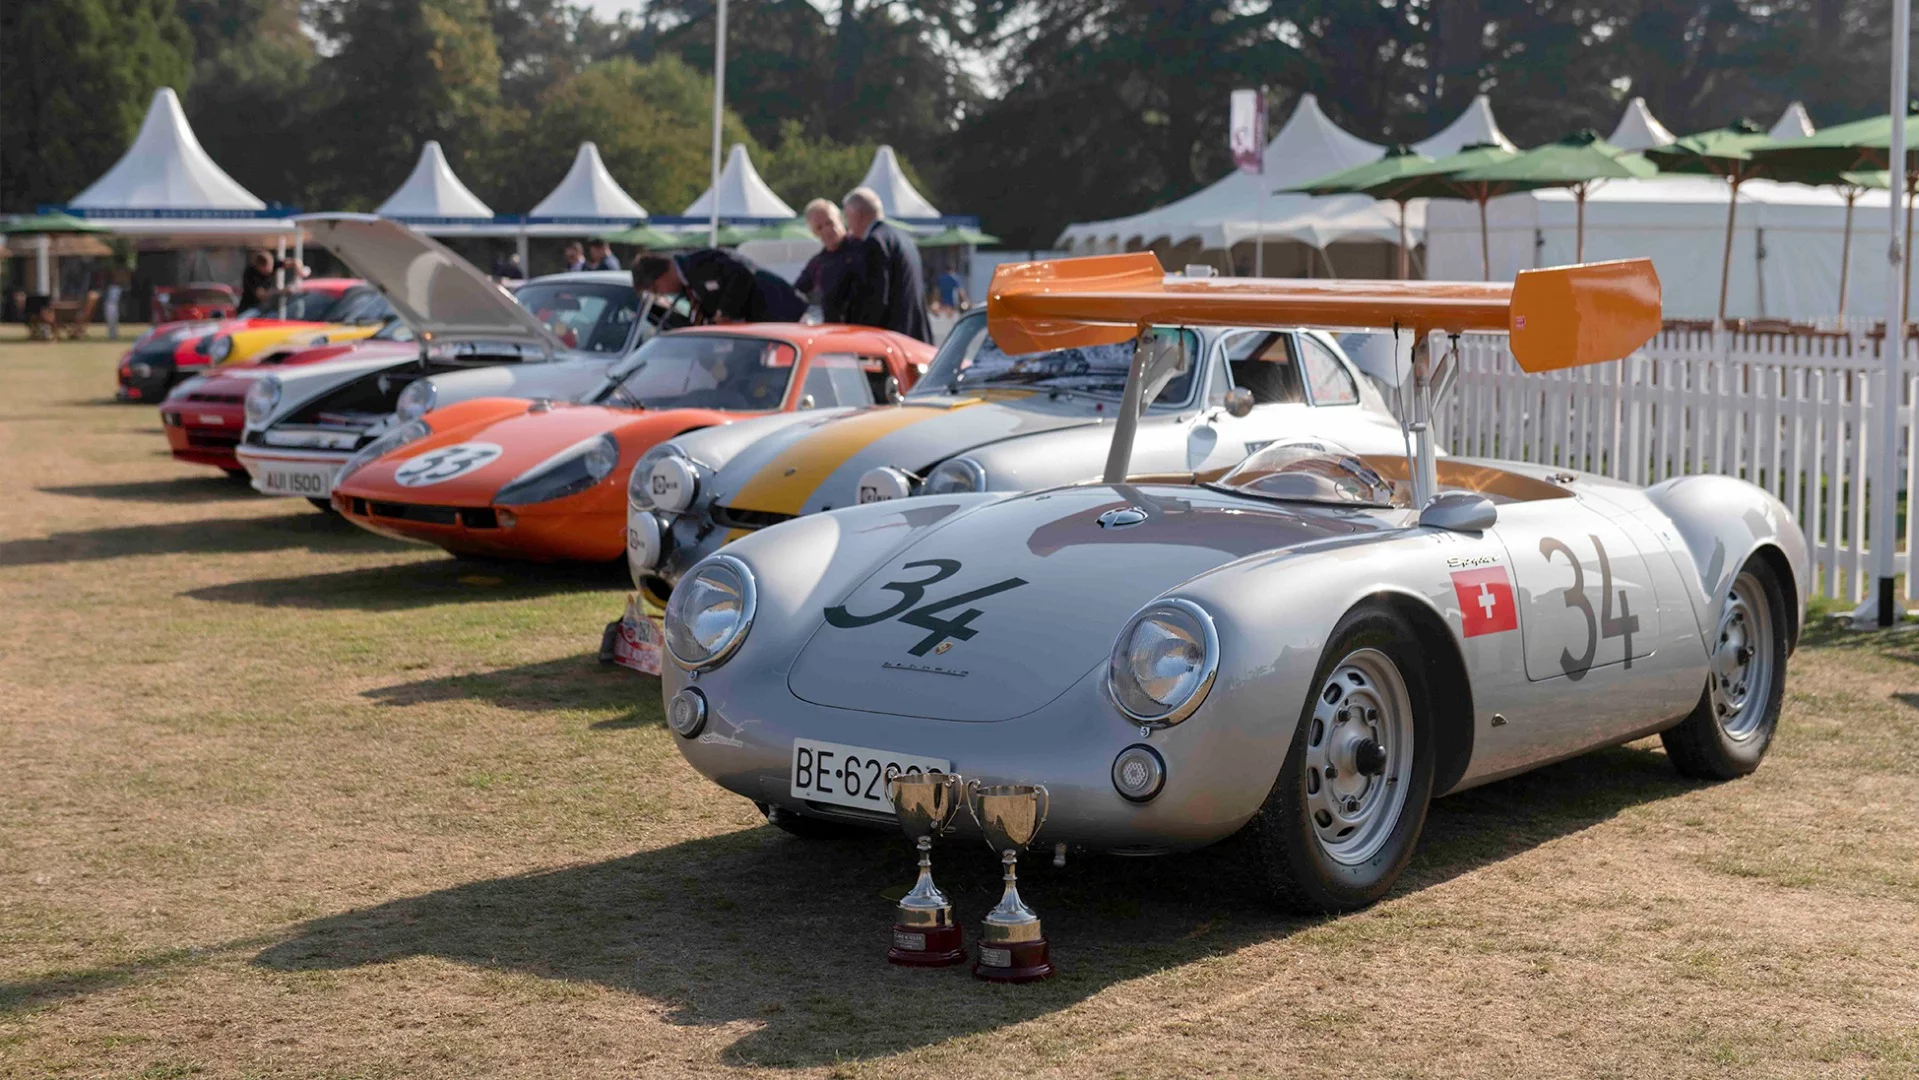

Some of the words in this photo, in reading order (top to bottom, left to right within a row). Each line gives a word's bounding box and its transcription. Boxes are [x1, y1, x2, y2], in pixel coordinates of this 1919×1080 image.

[289, 472, 321, 492] 1500
[397, 447, 498, 480] 33
[824, 558, 1030, 657] 34
[1539, 533, 1640, 682] 34
